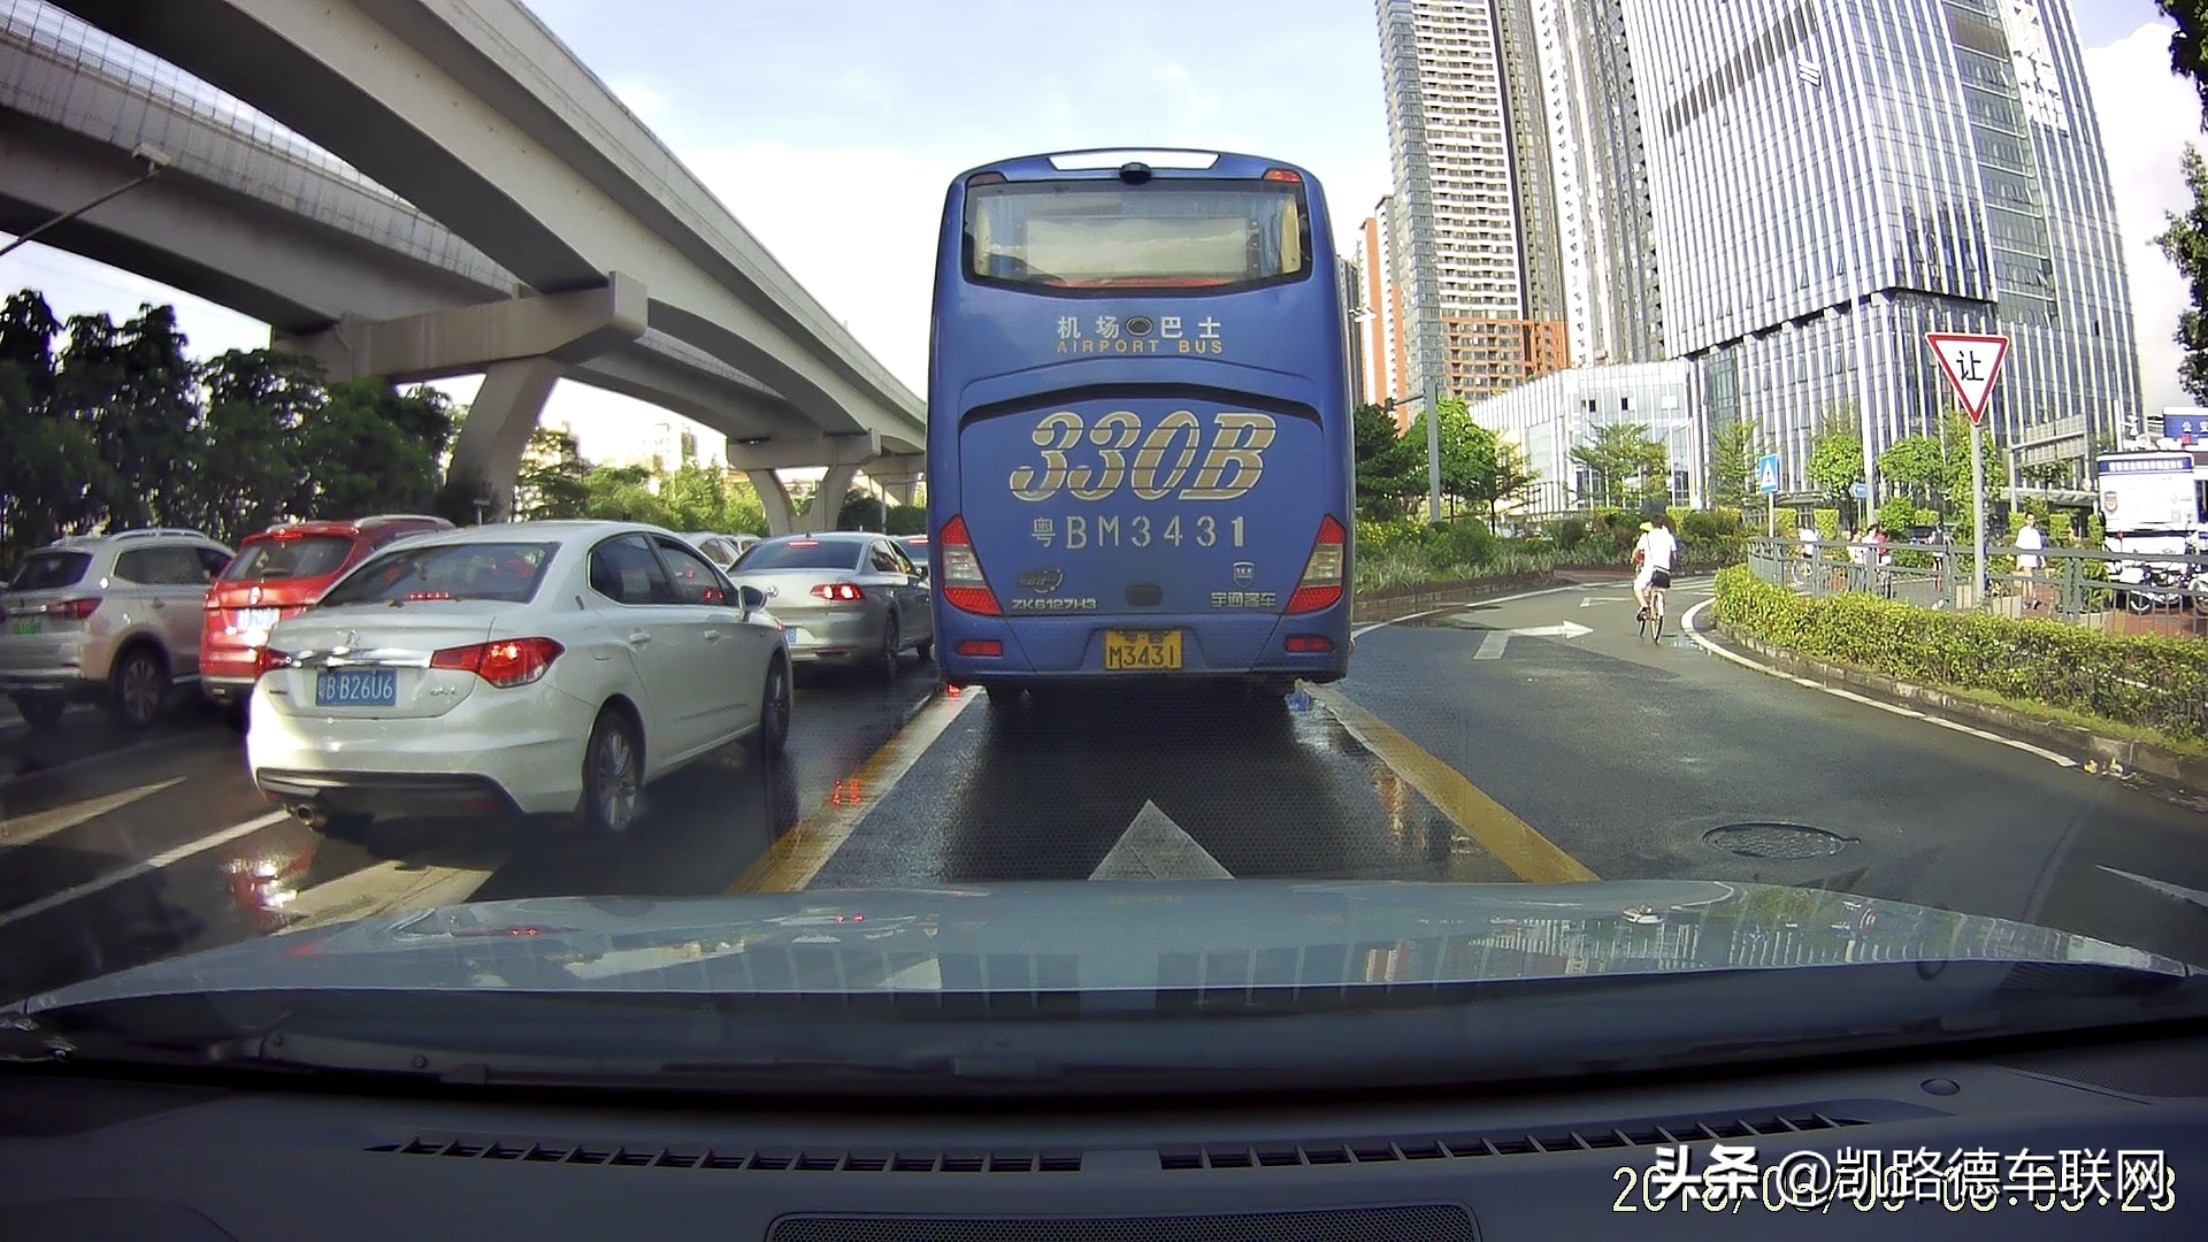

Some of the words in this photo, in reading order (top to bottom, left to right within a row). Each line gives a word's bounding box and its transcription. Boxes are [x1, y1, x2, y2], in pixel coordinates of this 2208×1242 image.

[1057, 316, 1221, 339] 机场巴士
[1057, 340, 1160, 353] AIRPORT
[1179, 340, 1222, 354] BUS
[1956, 350, 1984, 381] 让
[1009, 410, 1277, 501] 330B
[1211, 592, 1276, 608] 宇通客车
[1109, 645, 1174, 668] M3431
